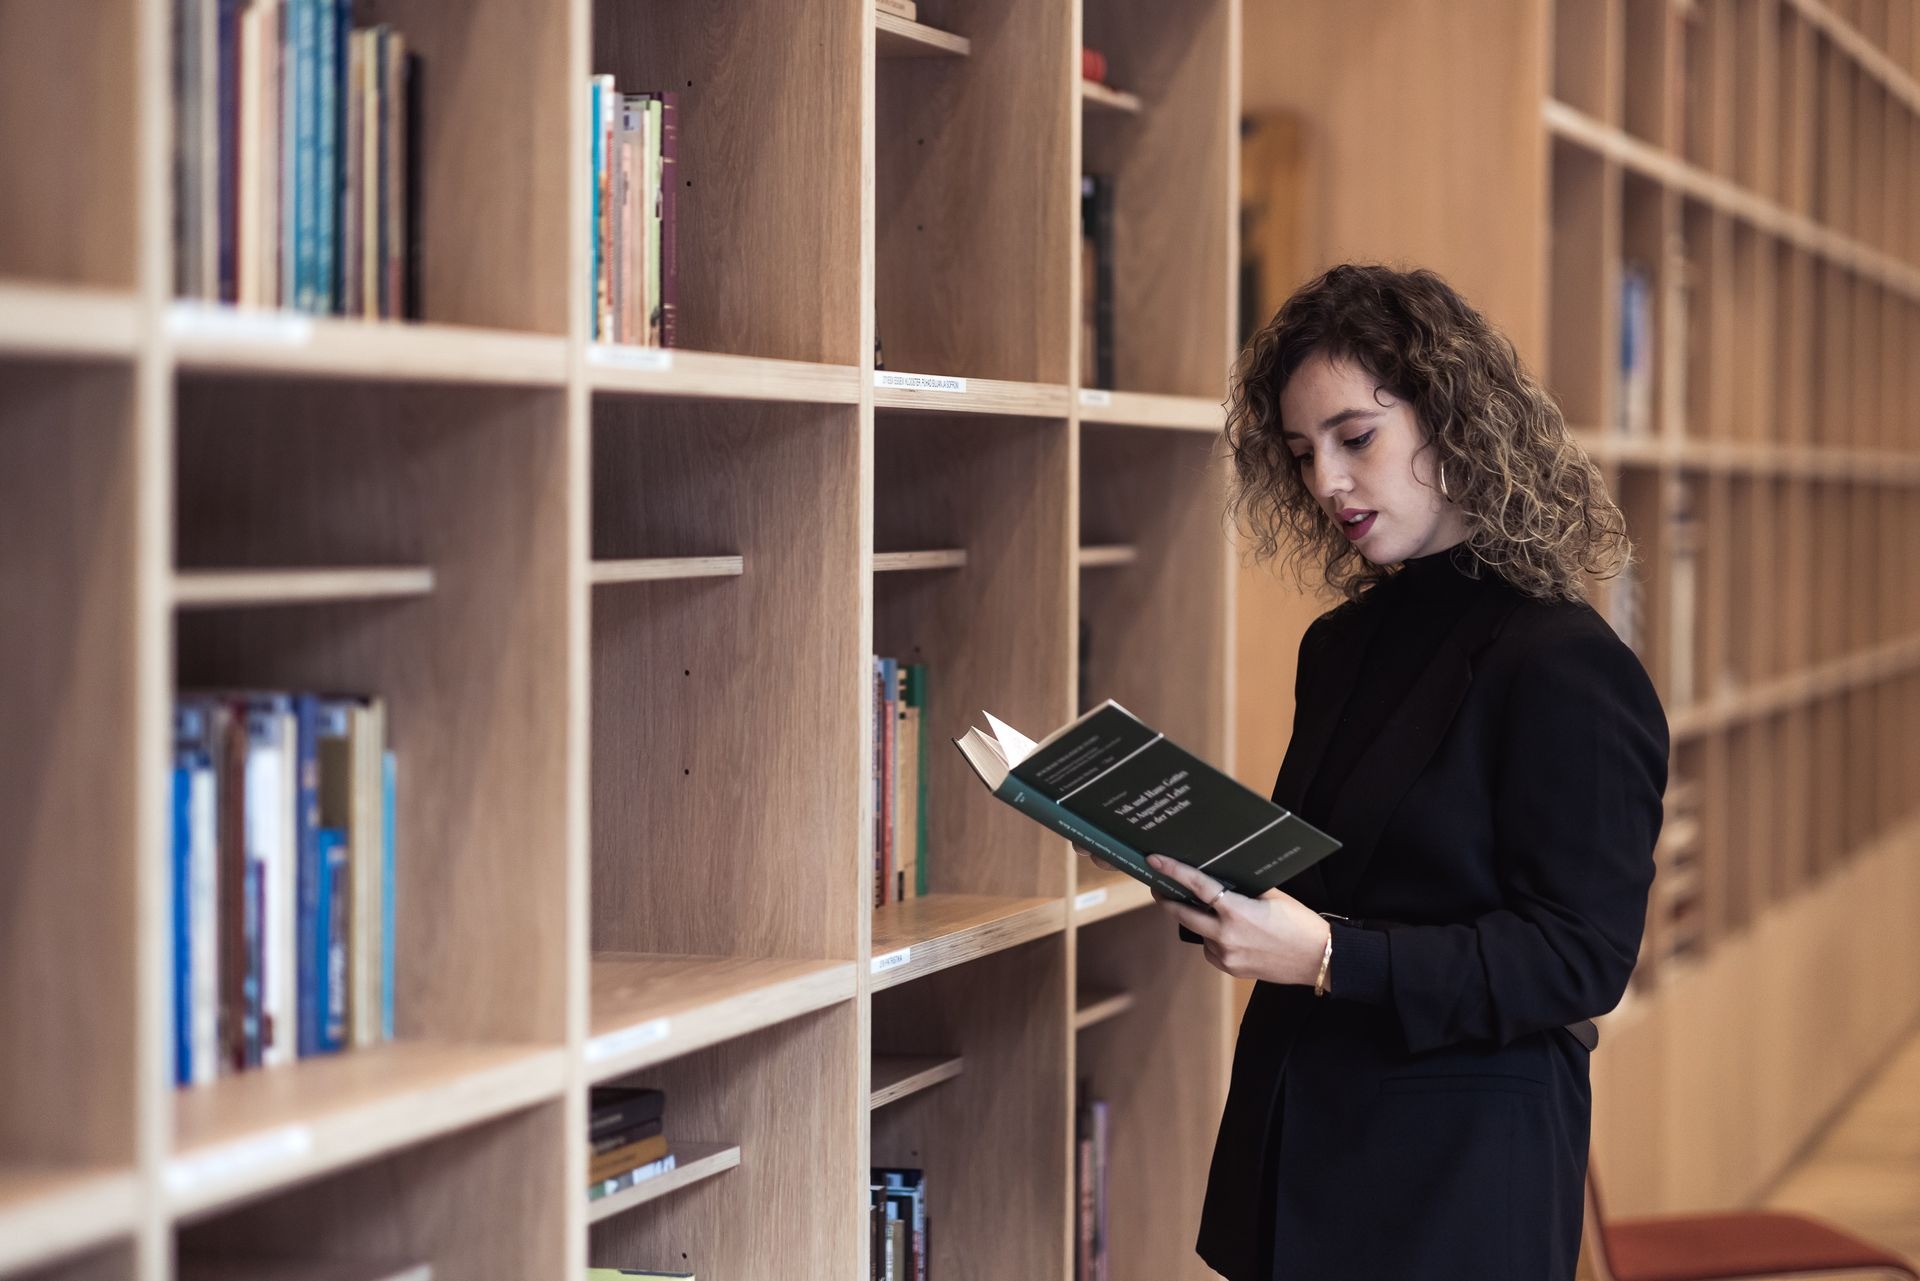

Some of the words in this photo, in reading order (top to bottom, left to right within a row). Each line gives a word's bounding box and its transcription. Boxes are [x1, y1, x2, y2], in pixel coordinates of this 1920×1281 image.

[1114, 804, 1135, 815] Volk
[1132, 794, 1148, 807] und
[1144, 786, 1166, 799] Haus
[1162, 770, 1189, 787] Gottes
[1126, 816, 1139, 824] in
[1141, 821, 1157, 831] von
[1153, 813, 1168, 824] der
[1164, 799, 1191, 816] Kirche
